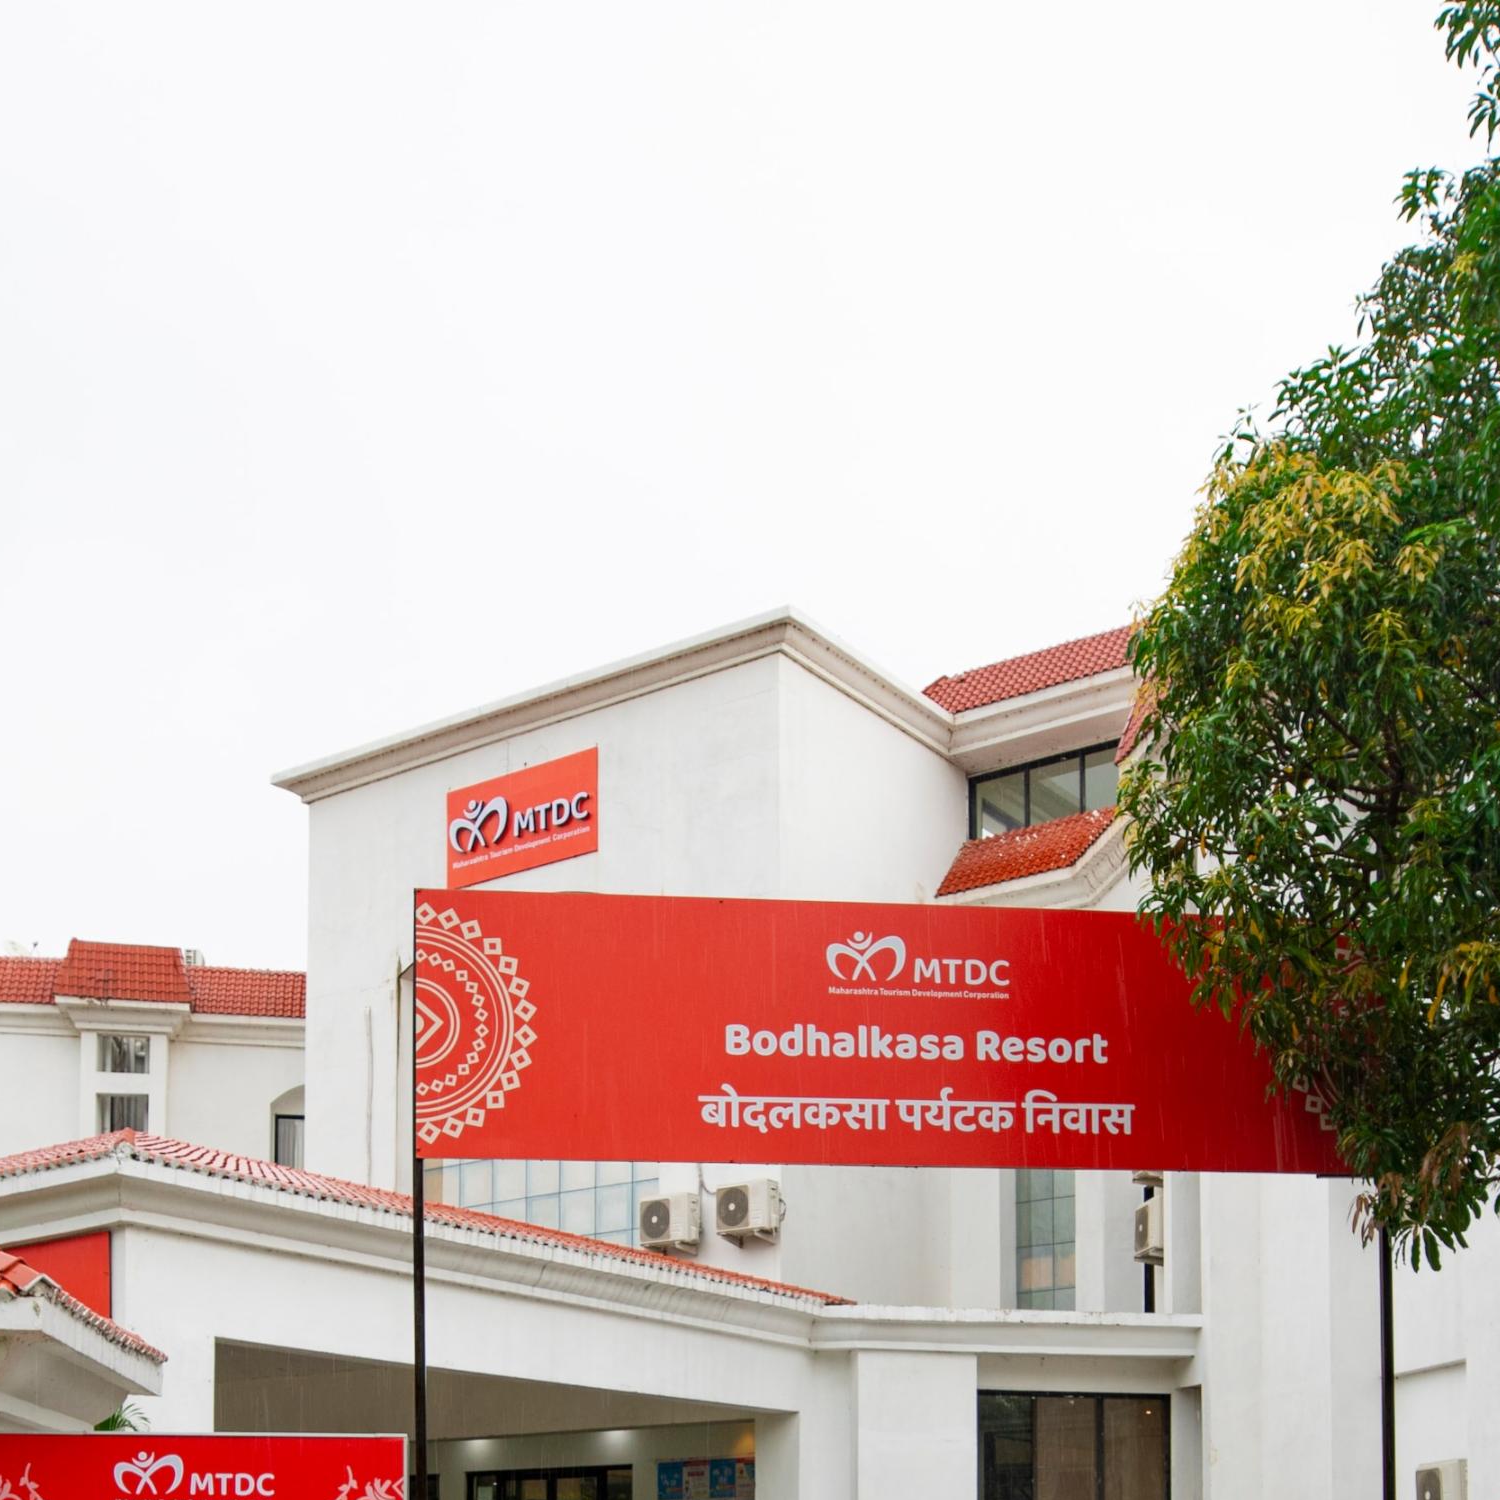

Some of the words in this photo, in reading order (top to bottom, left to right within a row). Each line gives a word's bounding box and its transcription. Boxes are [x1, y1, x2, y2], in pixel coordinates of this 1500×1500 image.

[513, 791, 590, 838] MTDC
[452, 854, 488, 869] Maharashtra
[490, 847, 513, 859] Tourism
[514, 837, 551, 852] Development
[552, 825, 590, 842] Corporation
[828, 985, 879, 996] Maharashtra
[879, 987, 910, 997] Tourism
[912, 988, 962, 998] Development
[963, 990, 1010, 1000] Corporation
[912, 957, 1010, 989] MTDC
[725, 1022, 965, 1061] Bodhalkasa
[977, 1029, 1109, 1064] Resort
[698, 1083, 888, 1132] बोदलकसा
[896, 1087, 1014, 1134] पर्यटक
[1022, 1088, 1135, 1136] निवास
[189, 1472, 275, 1496] MTDC
